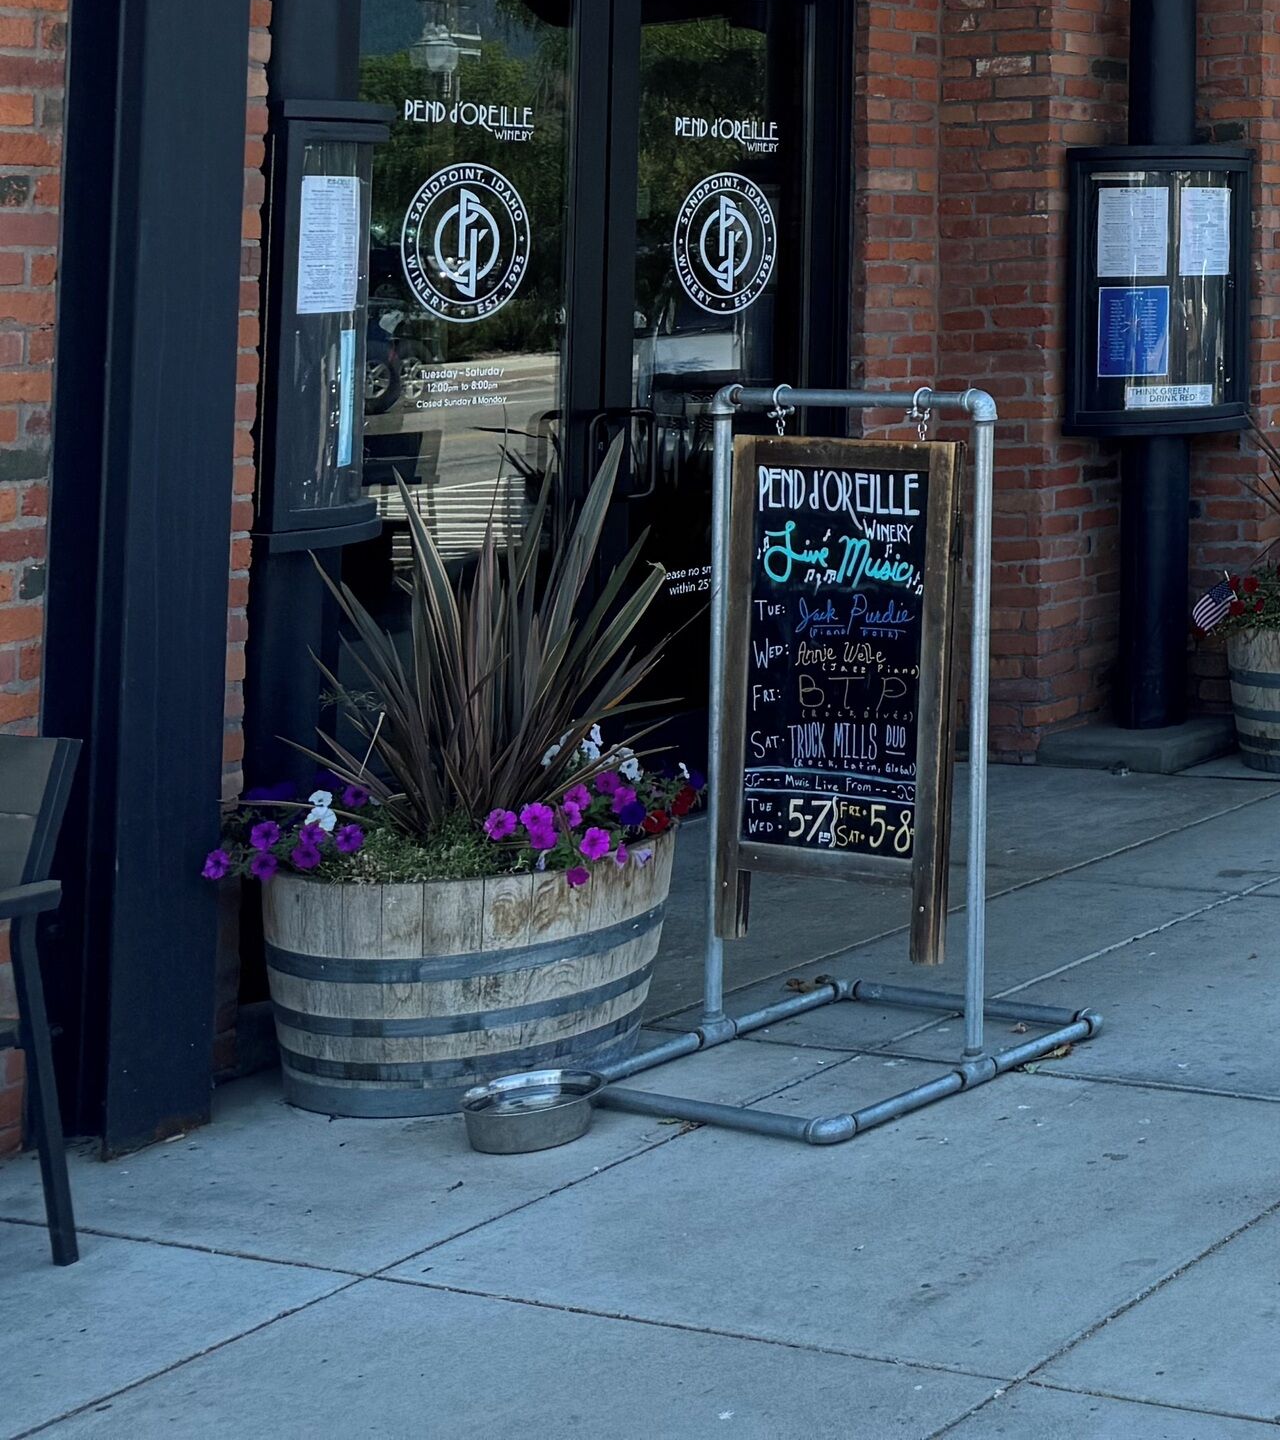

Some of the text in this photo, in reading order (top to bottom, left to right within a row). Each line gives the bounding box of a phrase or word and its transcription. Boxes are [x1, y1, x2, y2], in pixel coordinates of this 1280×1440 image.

[404, 98, 534, 132] PEND d'OREILLE
[494, 129, 534, 142] WINERY
[675, 116, 779, 145] PEND d'OREILLE
[746, 141, 779, 153] WINERY
[410, 168, 523, 221] SANDPOINT, IDAHO
[680, 177, 770, 225] SANDPOINT, IDAHO
[406, 254, 448, 311] WINERY
[476, 255, 525, 315] EST. 1995
[678, 254, 712, 305] WINERY
[734, 254, 772, 307] EST. 1995
[421, 369, 458, 379] Tuesday
[465, 367, 505, 377] Saturday
[461, 383, 468, 391] to
[416, 399, 442, 408] Closed
[444, 398, 470, 407] Sunday
[478, 396, 507, 404] Monday
[1131, 388, 1159, 396] THINK
[1149, 394, 1177, 403] DRINK
[758, 465, 920, 530] PEND d'OREILLE
[862, 517, 914, 544] WINERY
[763, 520, 914, 588] Live Music
[688, 567, 700, 577] no
[669, 581, 696, 596] within
[754, 593, 915, 634] TUE: Jack Purdie
[753, 638, 790, 669] WED:
[795, 641, 837, 666] Annie
[753, 684, 781, 711] FRI:
[787, 721, 826, 759] TRUCK
[833, 722, 878, 760] MILLS
[885, 724, 906, 748] DUO
[815, 775, 839, 791] Live
[846, 777, 872, 792] From
